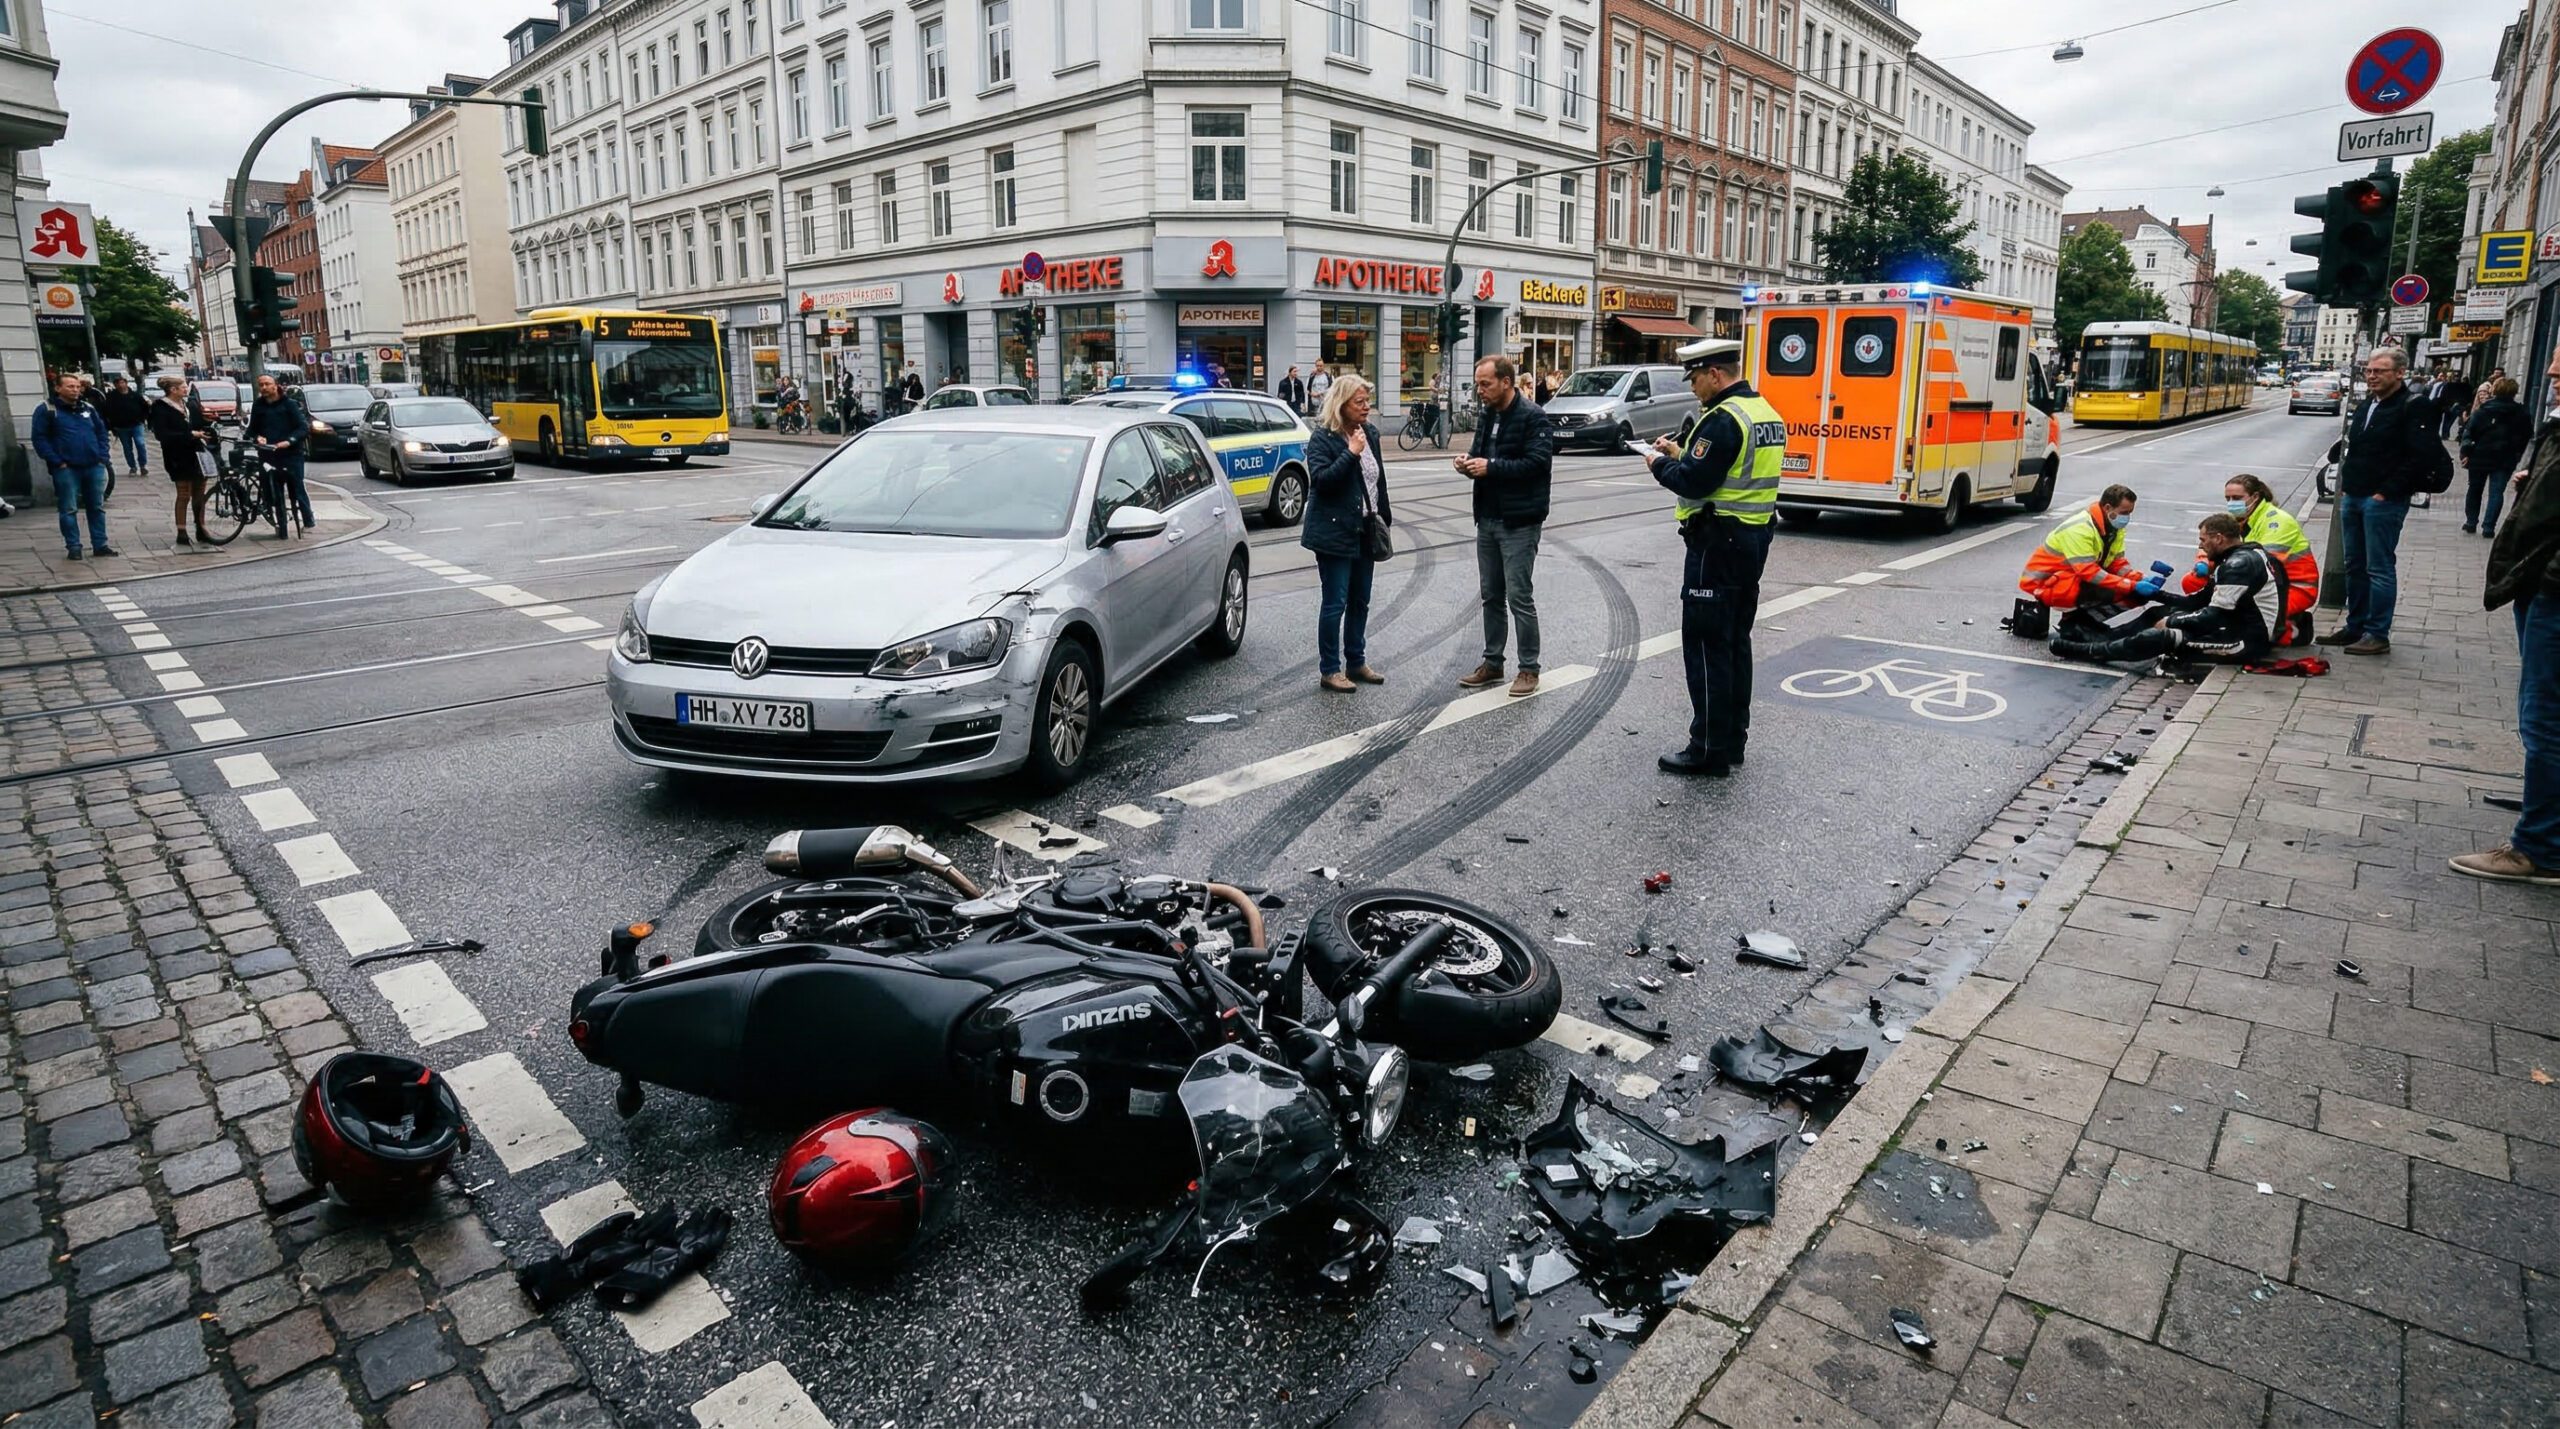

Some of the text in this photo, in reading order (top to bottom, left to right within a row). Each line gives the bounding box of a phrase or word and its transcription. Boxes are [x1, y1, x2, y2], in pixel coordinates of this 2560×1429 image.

[2347, 124, 2425, 151] Vorfahrt
[2485, 236, 2526, 270] E
[999, 256, 1122, 295] APTHEKE
[1316, 256, 1444, 293] APOTHEKE
[600, 319, 610, 336] 5
[1181, 309, 1261, 321] APOTHEKE
[1786, 423, 1893, 441] UNGSDIENST
[689, 698, 806, 729] HH XY 738
[1062, 1001, 1152, 1033] SUZUKI
